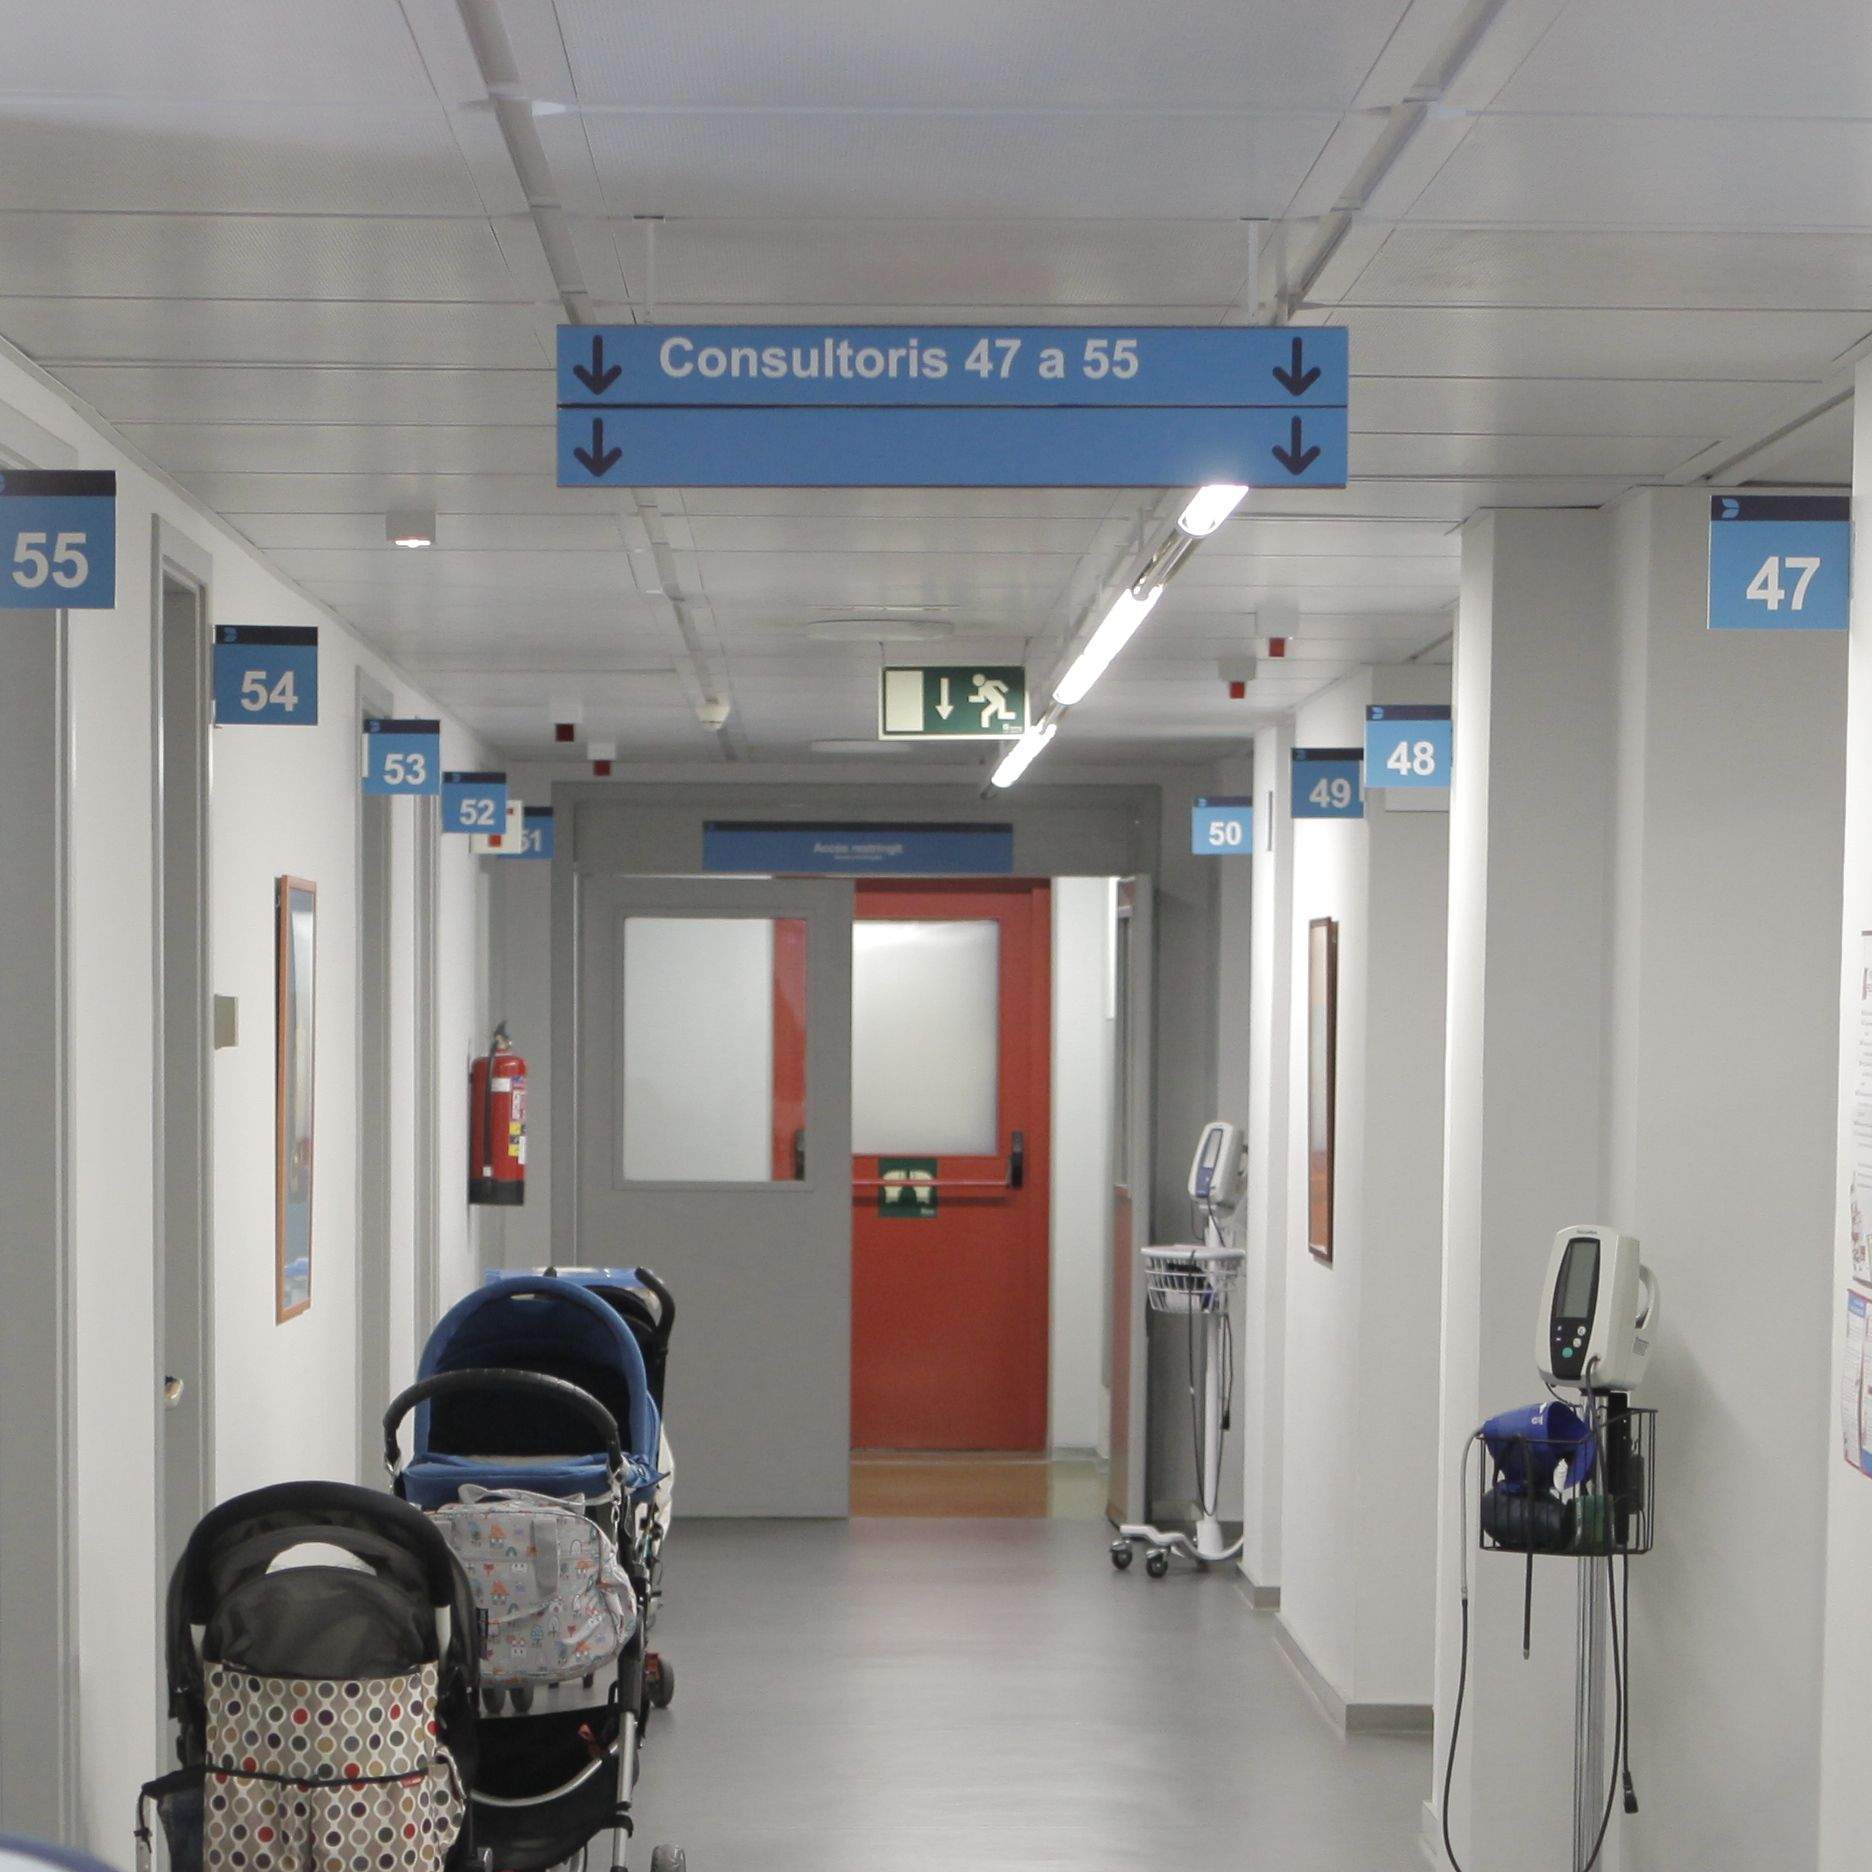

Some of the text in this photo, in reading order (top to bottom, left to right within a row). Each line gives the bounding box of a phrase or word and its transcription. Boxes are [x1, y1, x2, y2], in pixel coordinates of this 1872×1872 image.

[659, 336, 1139, 380] Consultoris 47 a 55
[11, 531, 89, 589] 55
[1745, 555, 1821, 612] 47
[240, 669, 299, 713] 54
[382, 752, 427, 787] 53
[1385, 740, 1436, 777] 48
[458, 797, 495, 826] 52
[1308, 778, 1351, 809] 49
[1208, 821, 1243, 847] 50
